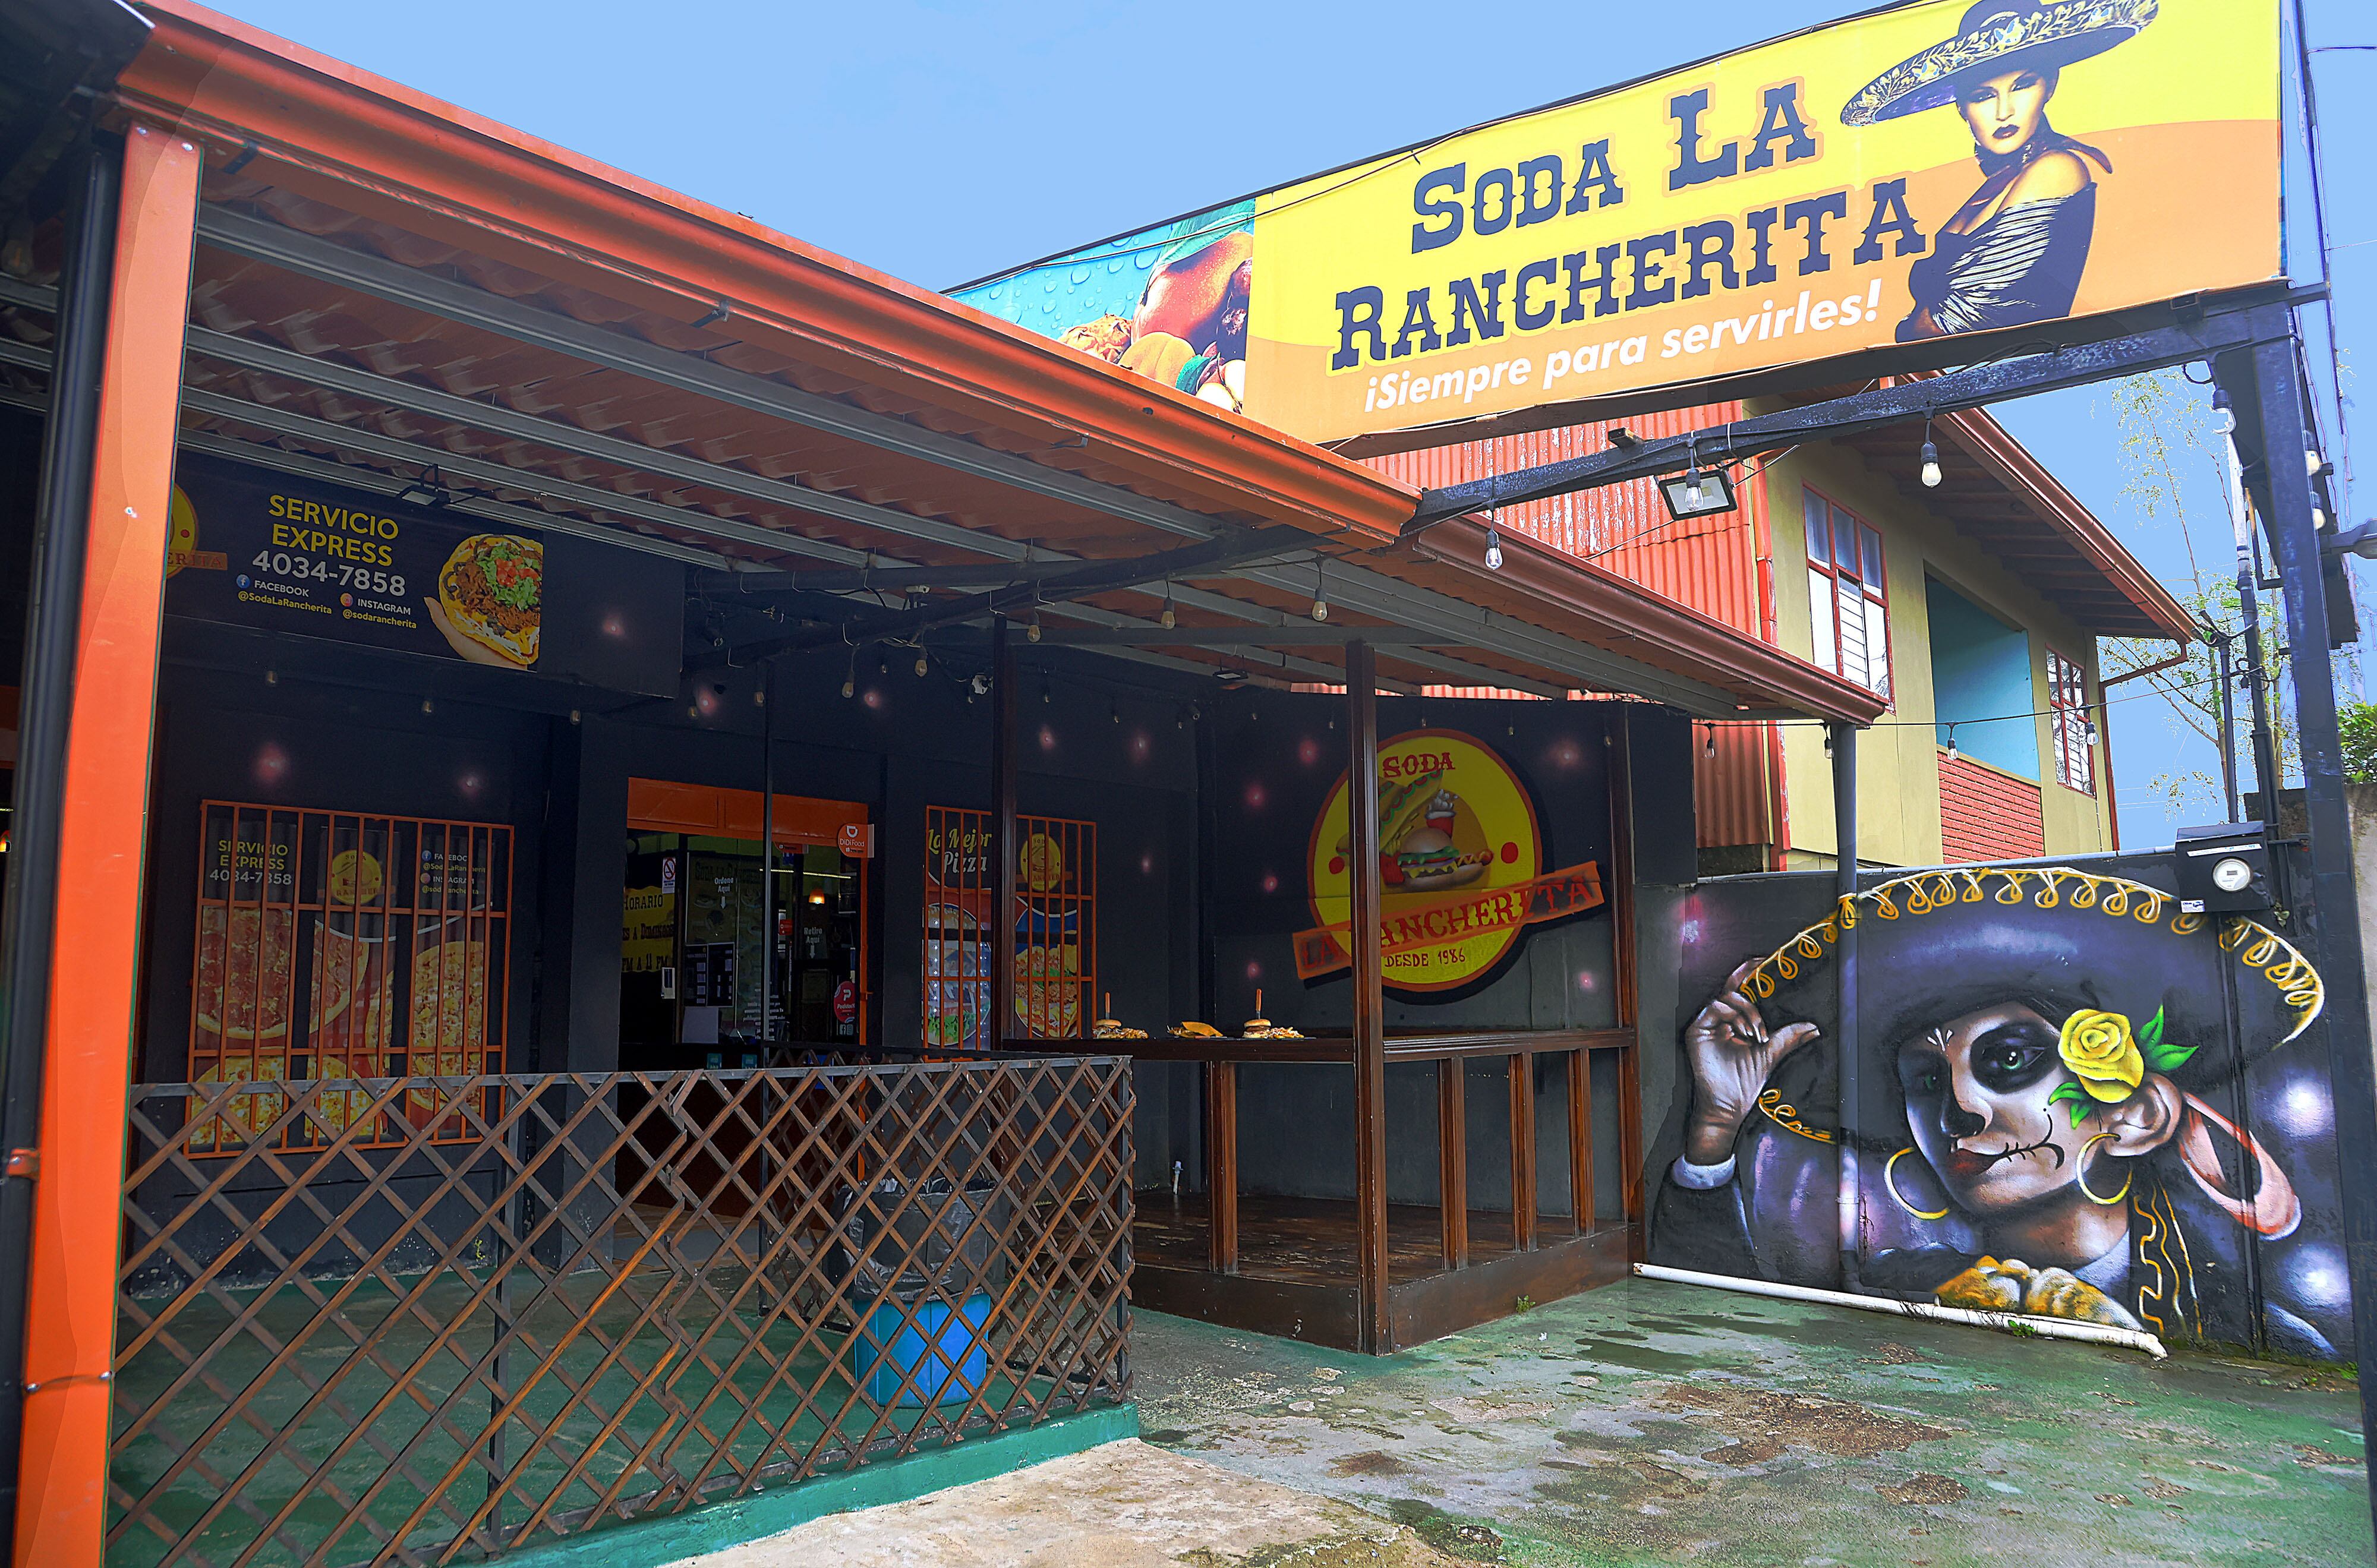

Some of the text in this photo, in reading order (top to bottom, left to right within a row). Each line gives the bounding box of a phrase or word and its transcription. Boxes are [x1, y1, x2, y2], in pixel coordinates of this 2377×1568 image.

[1411, 83, 1816, 254] SODA LA
[1333, 178, 1927, 371] RANCHERITA
[1542, 334, 1647, 390] para
[1660, 279, 1881, 359] servirles!
[269, 494, 399, 540] SERVICIO
[272, 523, 393, 566] EXPRESS
[252, 550, 406, 597] 4034-7858
[254, 580, 310, 597] FACEBOOK
[238, 591, 332, 614] @SodaLaRancherita
[342, 609, 417, 629] @sodarancherita
[358, 598, 411, 615] INSTAGRAM
[1382, 752, 1456, 778] SODA
[1349, 876, 1594, 949] ANCHERITA
[1384, 947, 1466, 968] DESDE 1986
